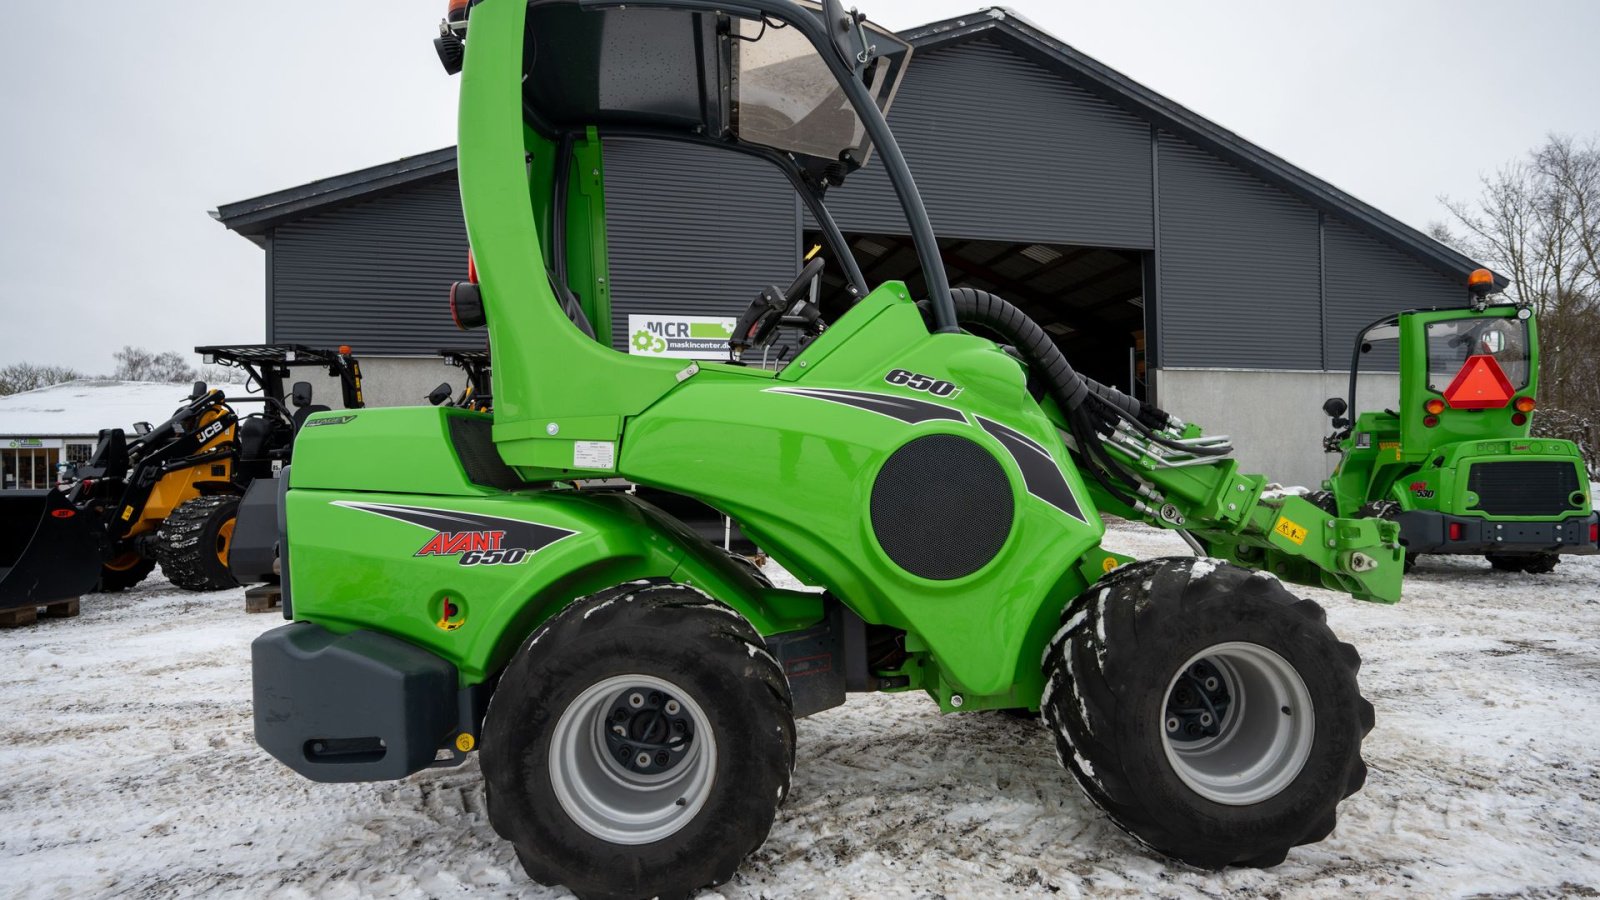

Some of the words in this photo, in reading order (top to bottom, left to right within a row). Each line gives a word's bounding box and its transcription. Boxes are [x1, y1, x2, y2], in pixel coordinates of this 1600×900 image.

[647, 321, 689, 337] MCR
[198, 420, 223, 443] JCB
[413, 531, 505, 556] AVANT
